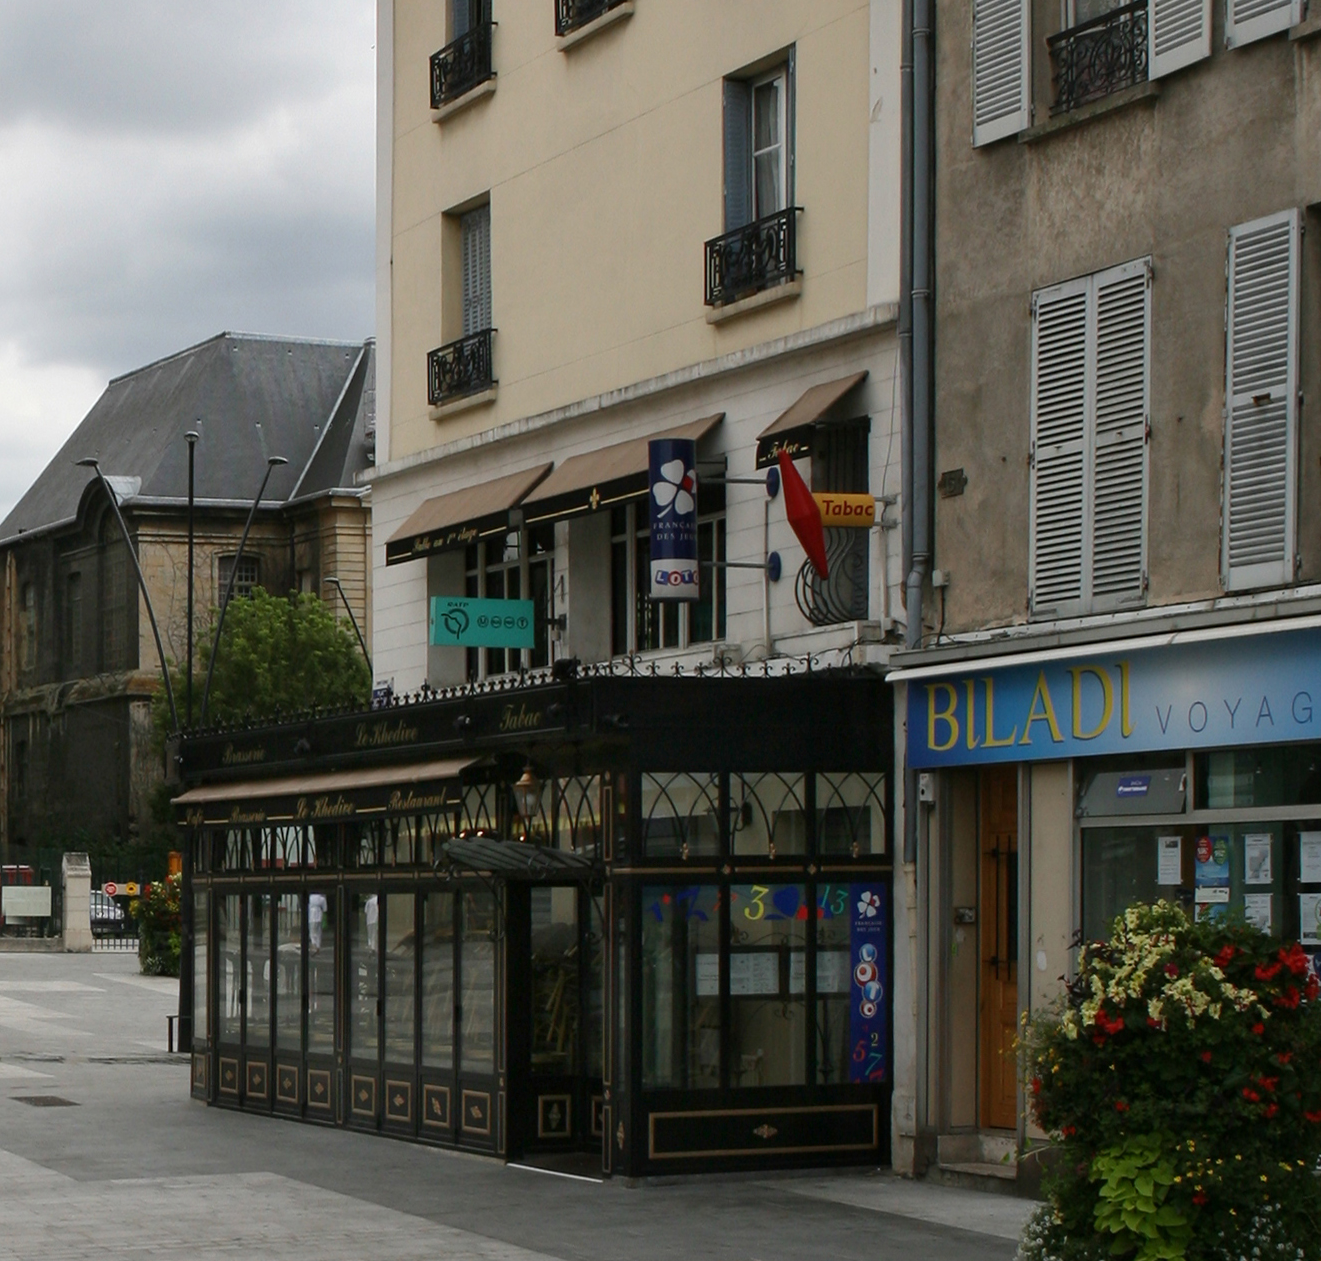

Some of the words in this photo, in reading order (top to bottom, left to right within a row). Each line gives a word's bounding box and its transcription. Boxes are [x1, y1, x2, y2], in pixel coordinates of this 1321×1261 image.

[822, 499, 873, 516] Tabac
[656, 532, 675, 541] DES
[499, 703, 541, 732] Tabac
[1155, 691, 1313, 735] VOYAG
[388, 786, 447, 811] Restaurant
[743, 884, 769, 921] 3
[870, 1032, 879, 1047] 2
[865, 1052, 883, 1077] 7
